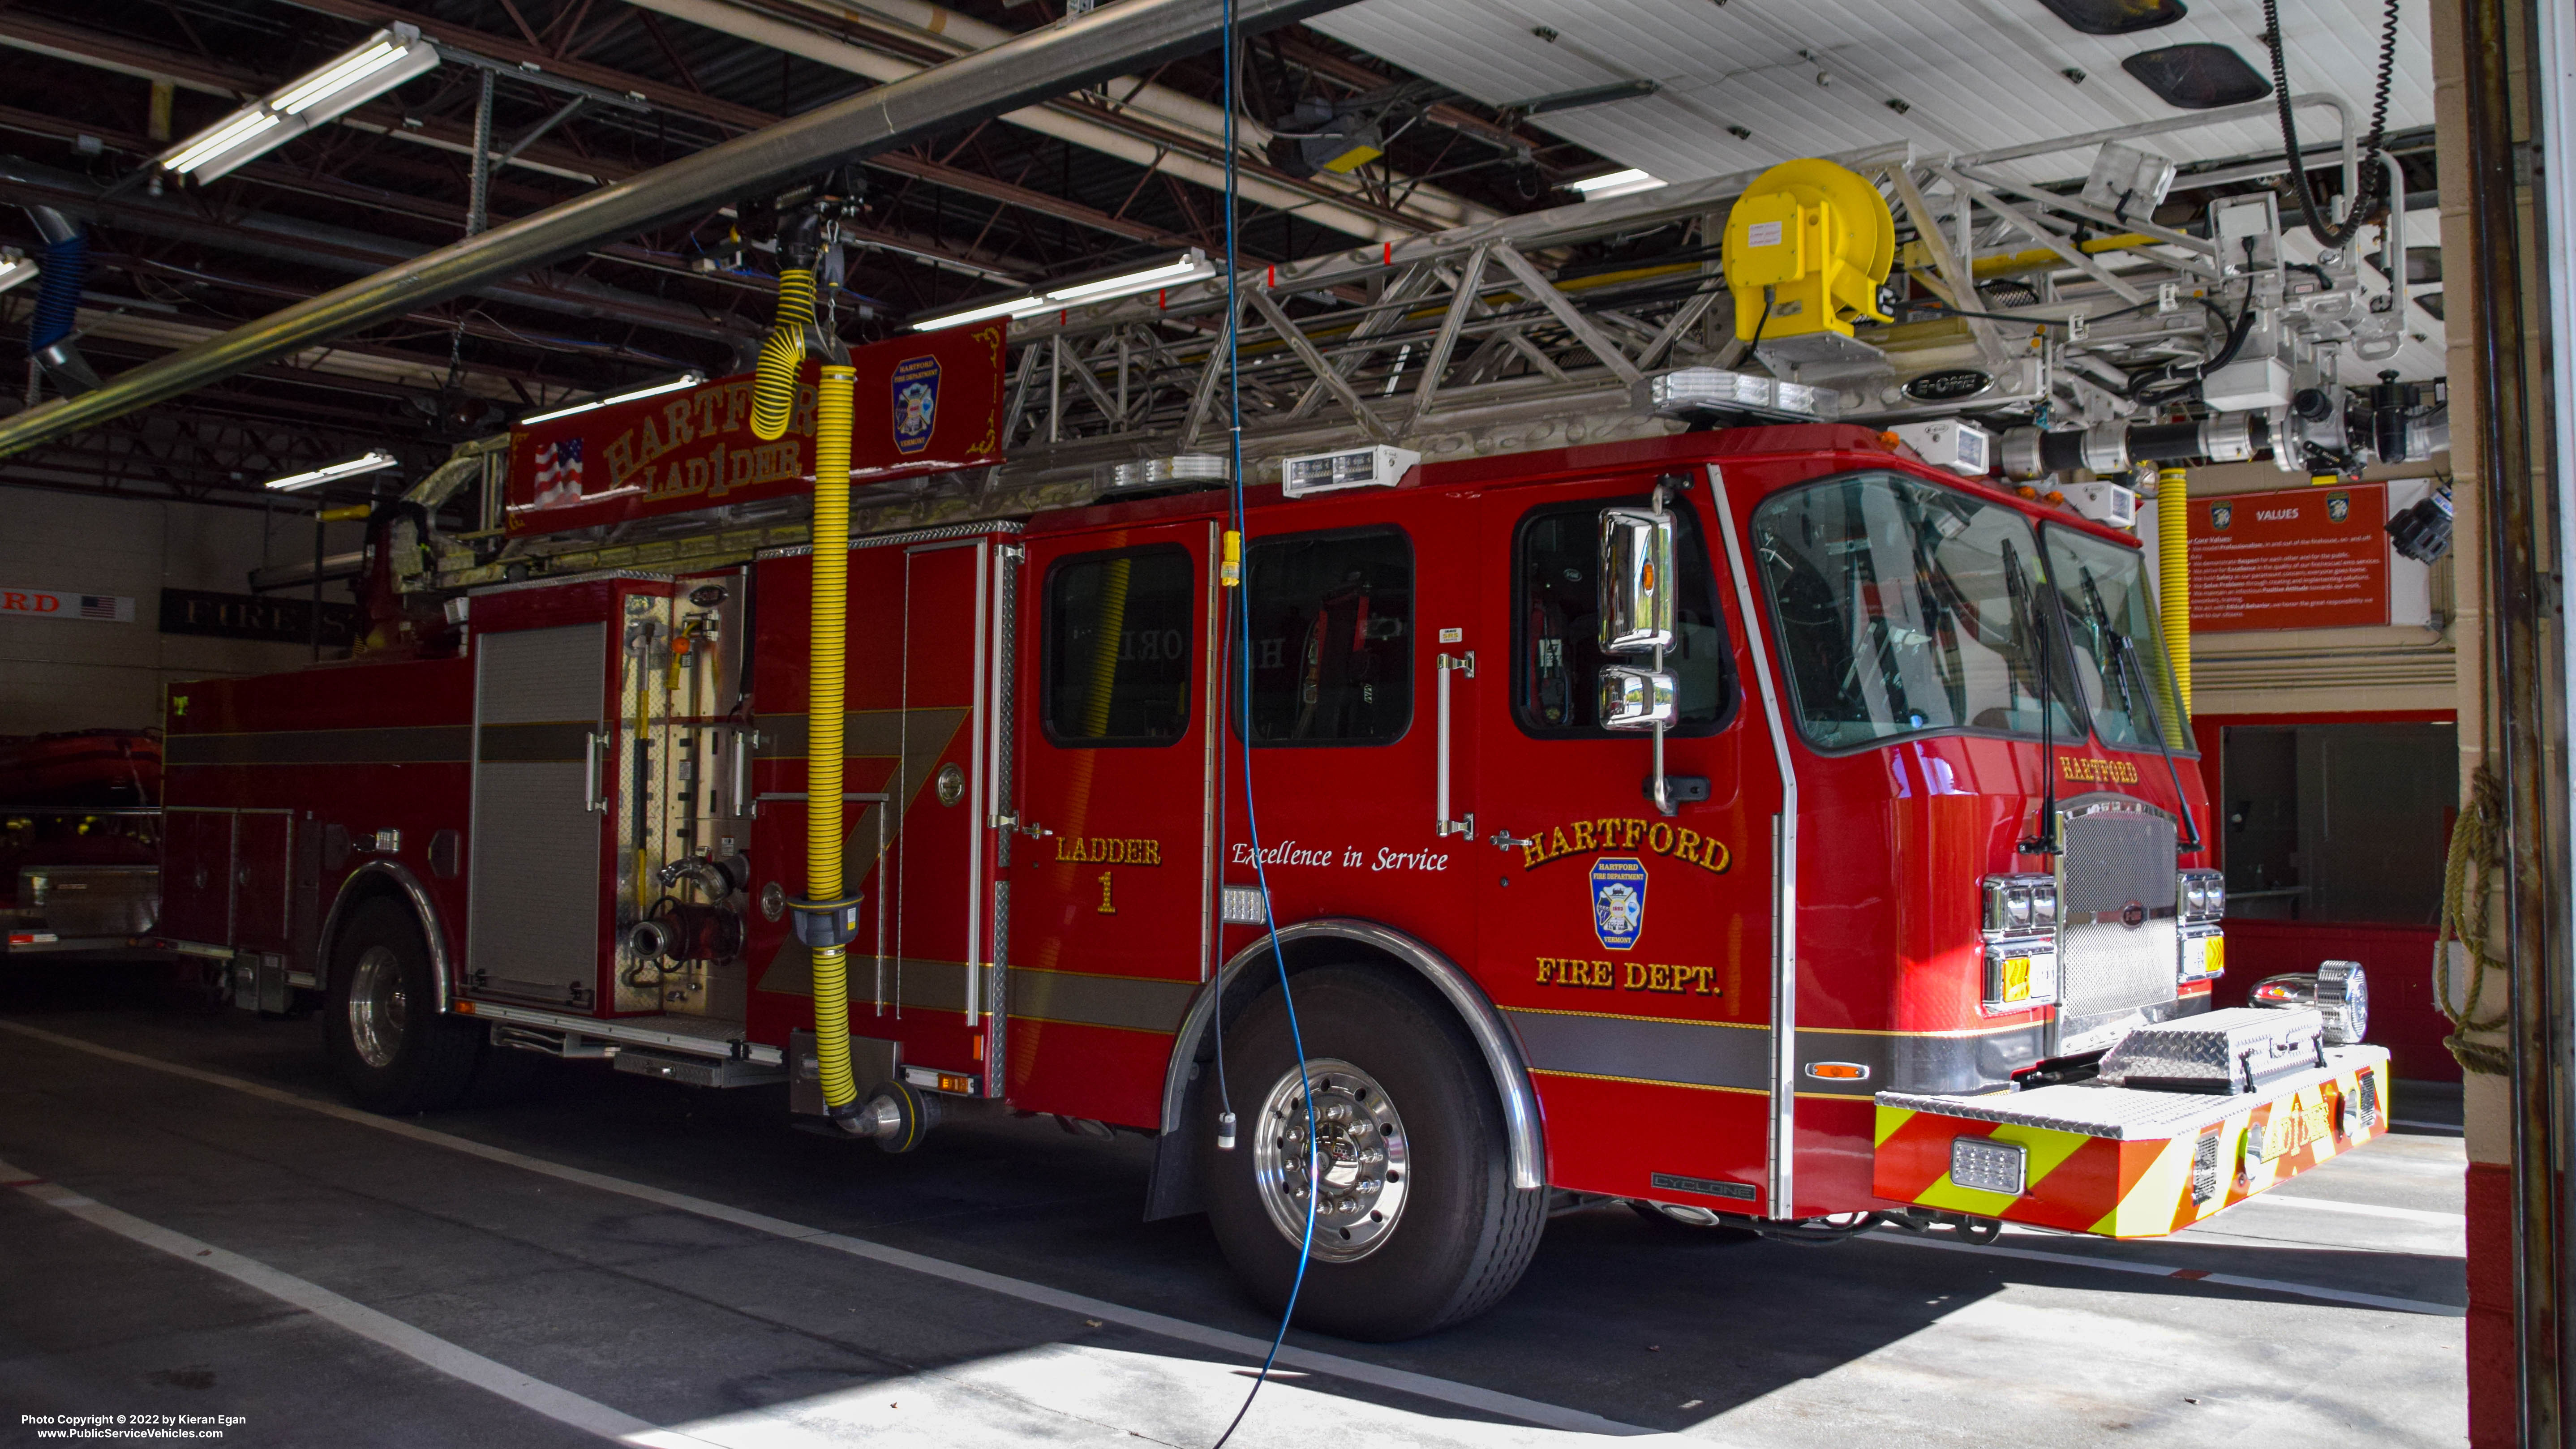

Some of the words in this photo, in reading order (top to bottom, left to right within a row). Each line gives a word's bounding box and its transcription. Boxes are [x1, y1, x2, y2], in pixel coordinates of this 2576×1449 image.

[1916, 374, 1977, 395] E-ONE
[2256, 508, 2299, 522] VALUES
[2059, 756, 2138, 784] HARTFORD
[1056, 837, 1161, 865] LADDER
[1232, 840, 1332, 869] Excellence
[1344, 845, 1363, 867] in
[1372, 847, 1448, 871] Service
[1522, 819, 1731, 873] HARTFORD
[1098, 871, 1116, 913] 1
[1536, 957, 1613, 986] FIRE
[1624, 962, 1722, 995] DEPT.
[1656, 1176, 1752, 1197] CYCLONE
